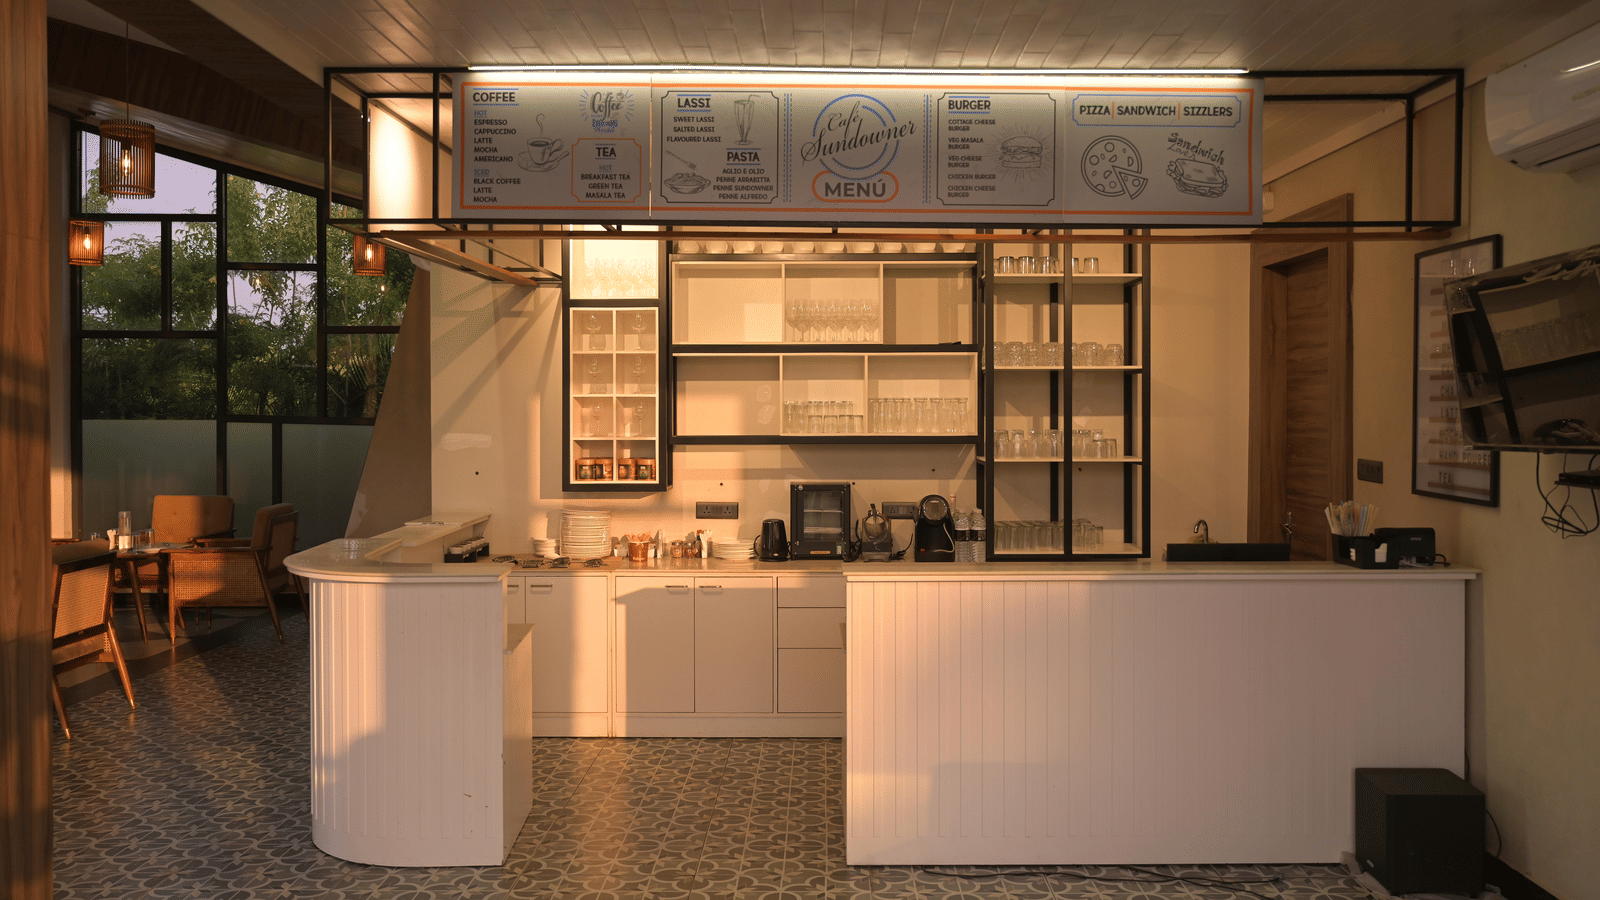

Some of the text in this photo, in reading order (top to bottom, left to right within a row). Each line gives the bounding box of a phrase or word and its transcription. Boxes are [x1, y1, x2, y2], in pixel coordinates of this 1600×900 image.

[473, 92, 516, 102] COFFEE
[677, 98, 711, 108] LASSI
[592, 91, 624, 121] Coffee
[948, 100, 991, 110] BURGER
[1079, 105, 1233, 117] PIZZA SANDWICH SIZZLERS
[827, 100, 860, 139] Café
[800, 118, 916, 167] Sundowner
[1167, 132, 1224, 165] Sandwich
[596, 147, 617, 157] TEA
[727, 152, 760, 162] PASTA
[825, 179, 886, 198] MENÚ
